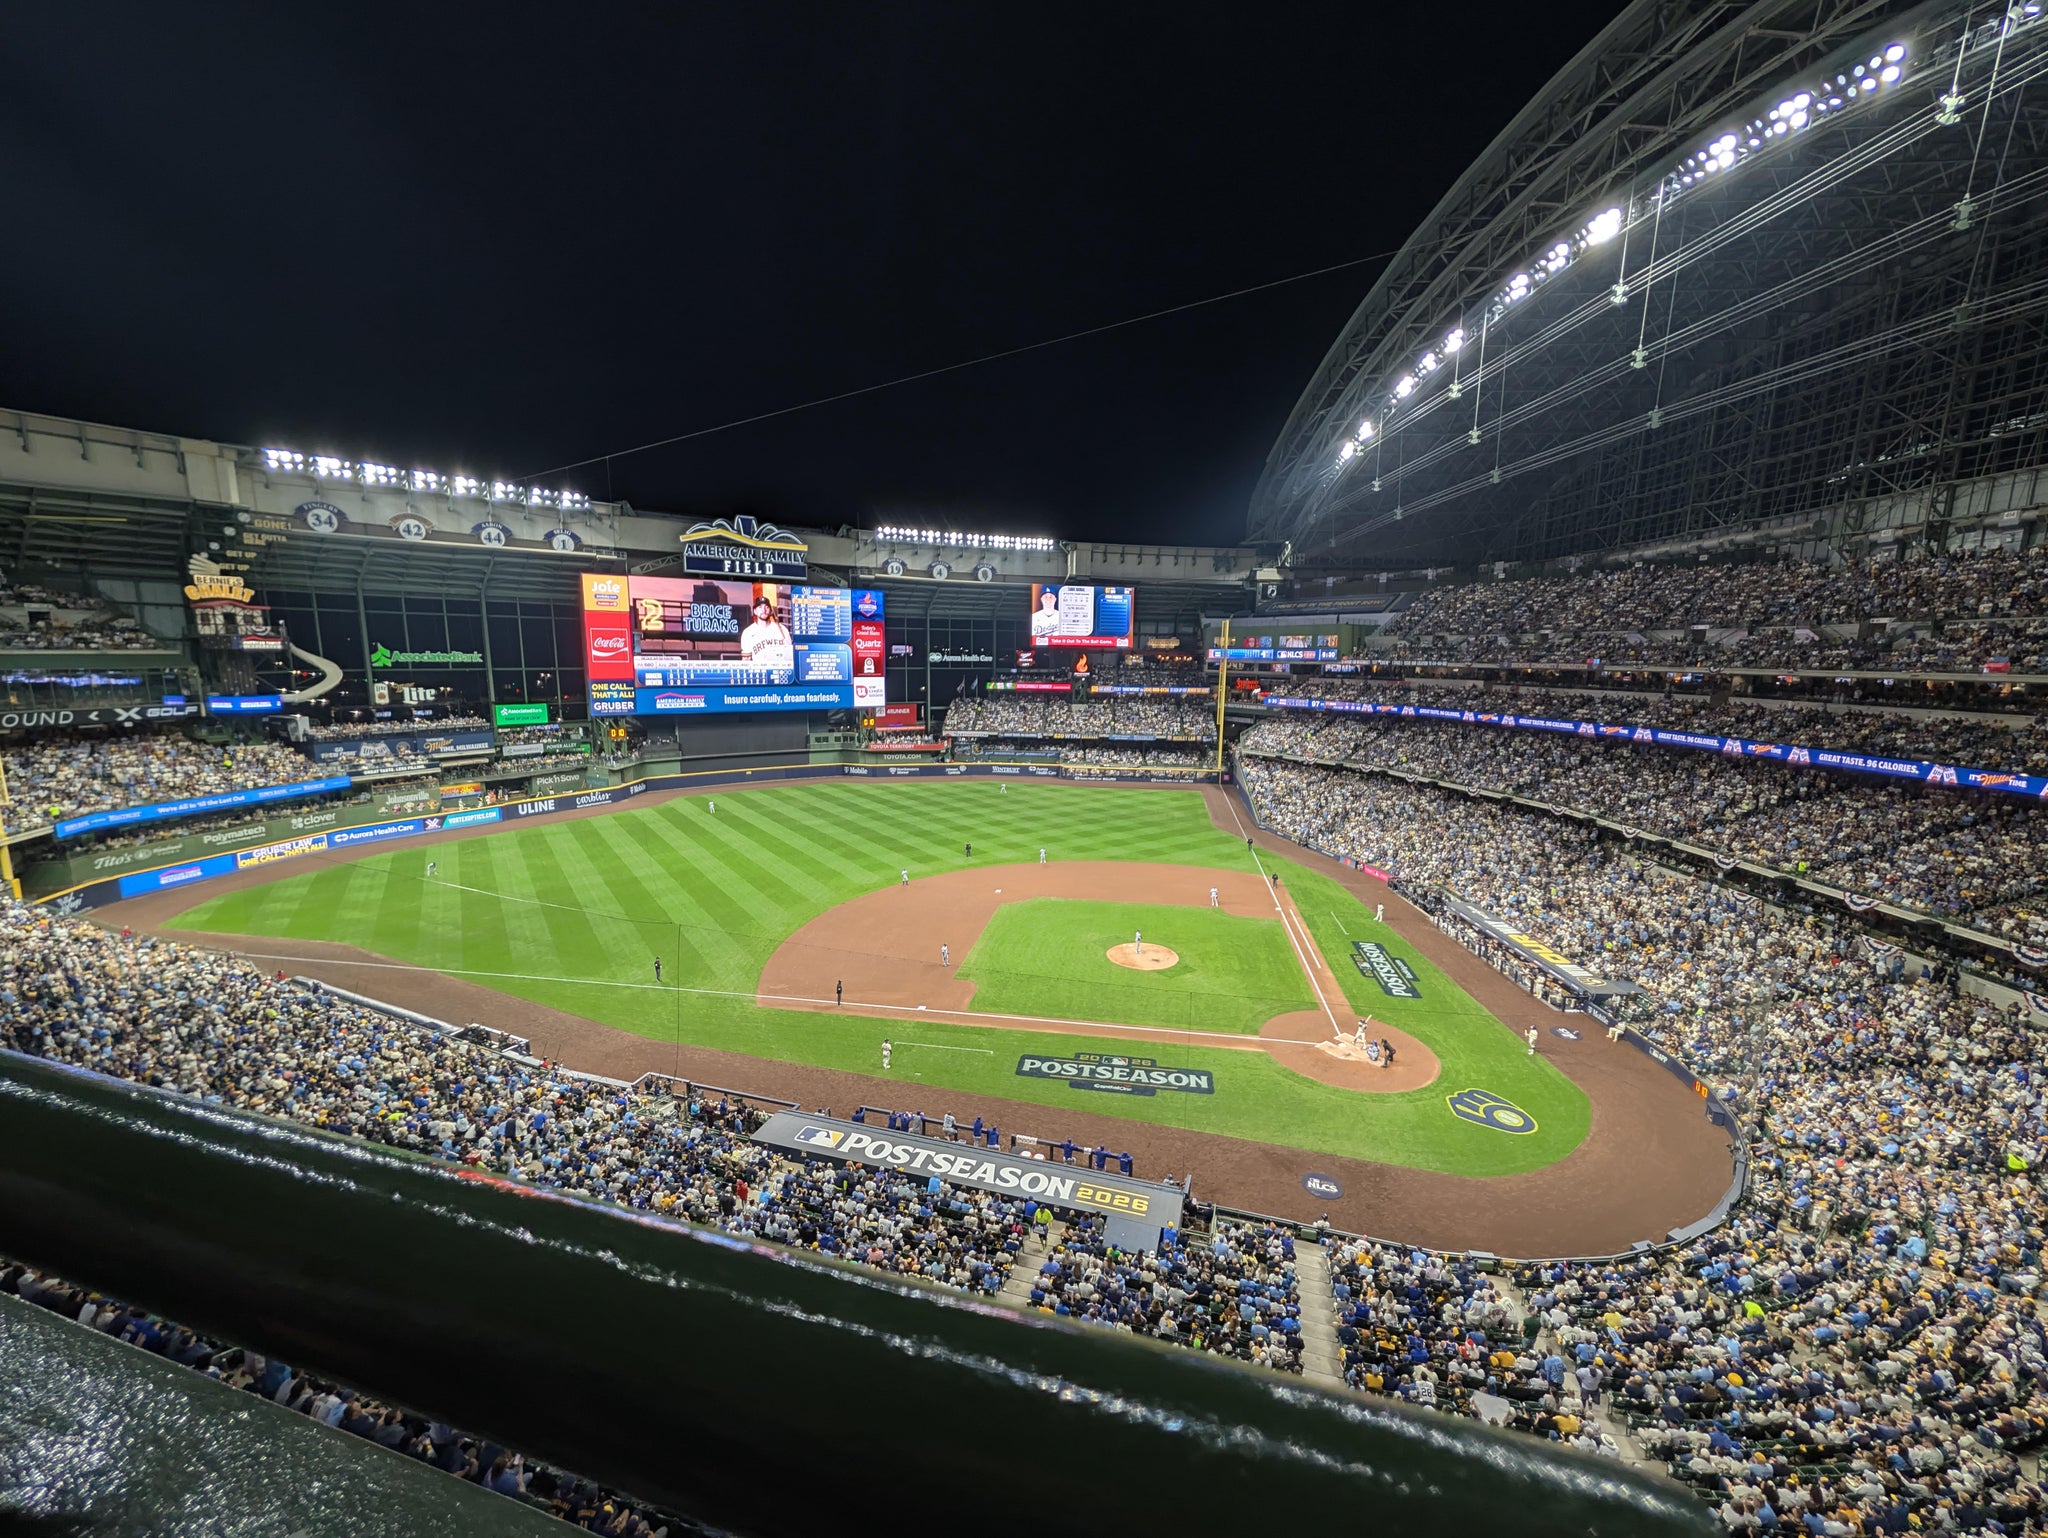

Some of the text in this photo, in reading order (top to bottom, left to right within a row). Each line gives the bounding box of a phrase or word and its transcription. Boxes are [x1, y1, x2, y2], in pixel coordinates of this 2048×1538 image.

[254, 519, 292, 531] GONE!
[311, 513, 334, 528] 34
[403, 523, 424, 536] 42
[484, 531, 501, 544] 44
[561, 540, 567, 550] 1
[226, 550, 257, 559] GET UP
[684, 543, 808, 565] AMERICAN FAMILY
[724, 560, 774, 575] FIELD
[890, 563, 900, 574] 19
[936, 567, 943, 577] 4
[196, 575, 244, 587] BERNIE'S
[592, 580, 620, 593] Joie
[184, 585, 255, 603] CHALET
[640, 599, 664, 631] 2
[690, 603, 733, 619] BRICE
[683, 617, 739, 633] TURANG
[594, 637, 626, 648] Coca-Cola
[855, 638, 882, 649] Quartz
[943, 654, 961, 662] Aurora
[980, 654, 993, 662] Care
[592, 691, 618, 699] THAT'S
[724, 692, 840, 705] Insure carefully, dream fearlessly.
[146, 705, 198, 717] GOLF
[593, 701, 634, 711] GRUBER
[2, 711, 74, 728] OUND
[618, 728, 625, 736] 10
[1657, 732, 1672, 740] GREAT
[1672, 734, 1686, 743] TASTE.
[1695, 737, 1719, 746] CALORIES.
[457, 742, 489, 751] MILWAUKEE
[1819, 753, 1919, 774] GREAT TASTE. 96 CALORIES.
[850, 767, 868, 775] Mobile
[537, 776, 552, 785] Pick
[561, 773, 580, 783] Save
[1980, 773, 2017, 786] Miller
[2009, 779, 2027, 788] TIME
[386, 790, 430, 806] Johnsonville
[157, 805, 177, 815] We're
[178, 803, 189, 811] All
[218, 797, 232, 806] Last
[232, 795, 245, 803] Out
[518, 800, 555, 815] ULINE
[303, 813, 336, 826] clover
[204, 825, 266, 845] Polymatech
[350, 824, 414, 840] Aurora Health Care
[252, 838, 313, 859] GRUBER LAW
[94, 852, 134, 870] Tito's
[241, 858, 259, 868] ONE
[1359, 942, 1413, 996] POSTSEASON
[1131, 1058, 1152, 1066] 26
[1021, 1058, 1209, 1089] POSTSEASON
[838, 1132, 1149, 1212] POSTSEASON 2026
[1307, 1180, 1339, 1192] NLCS
